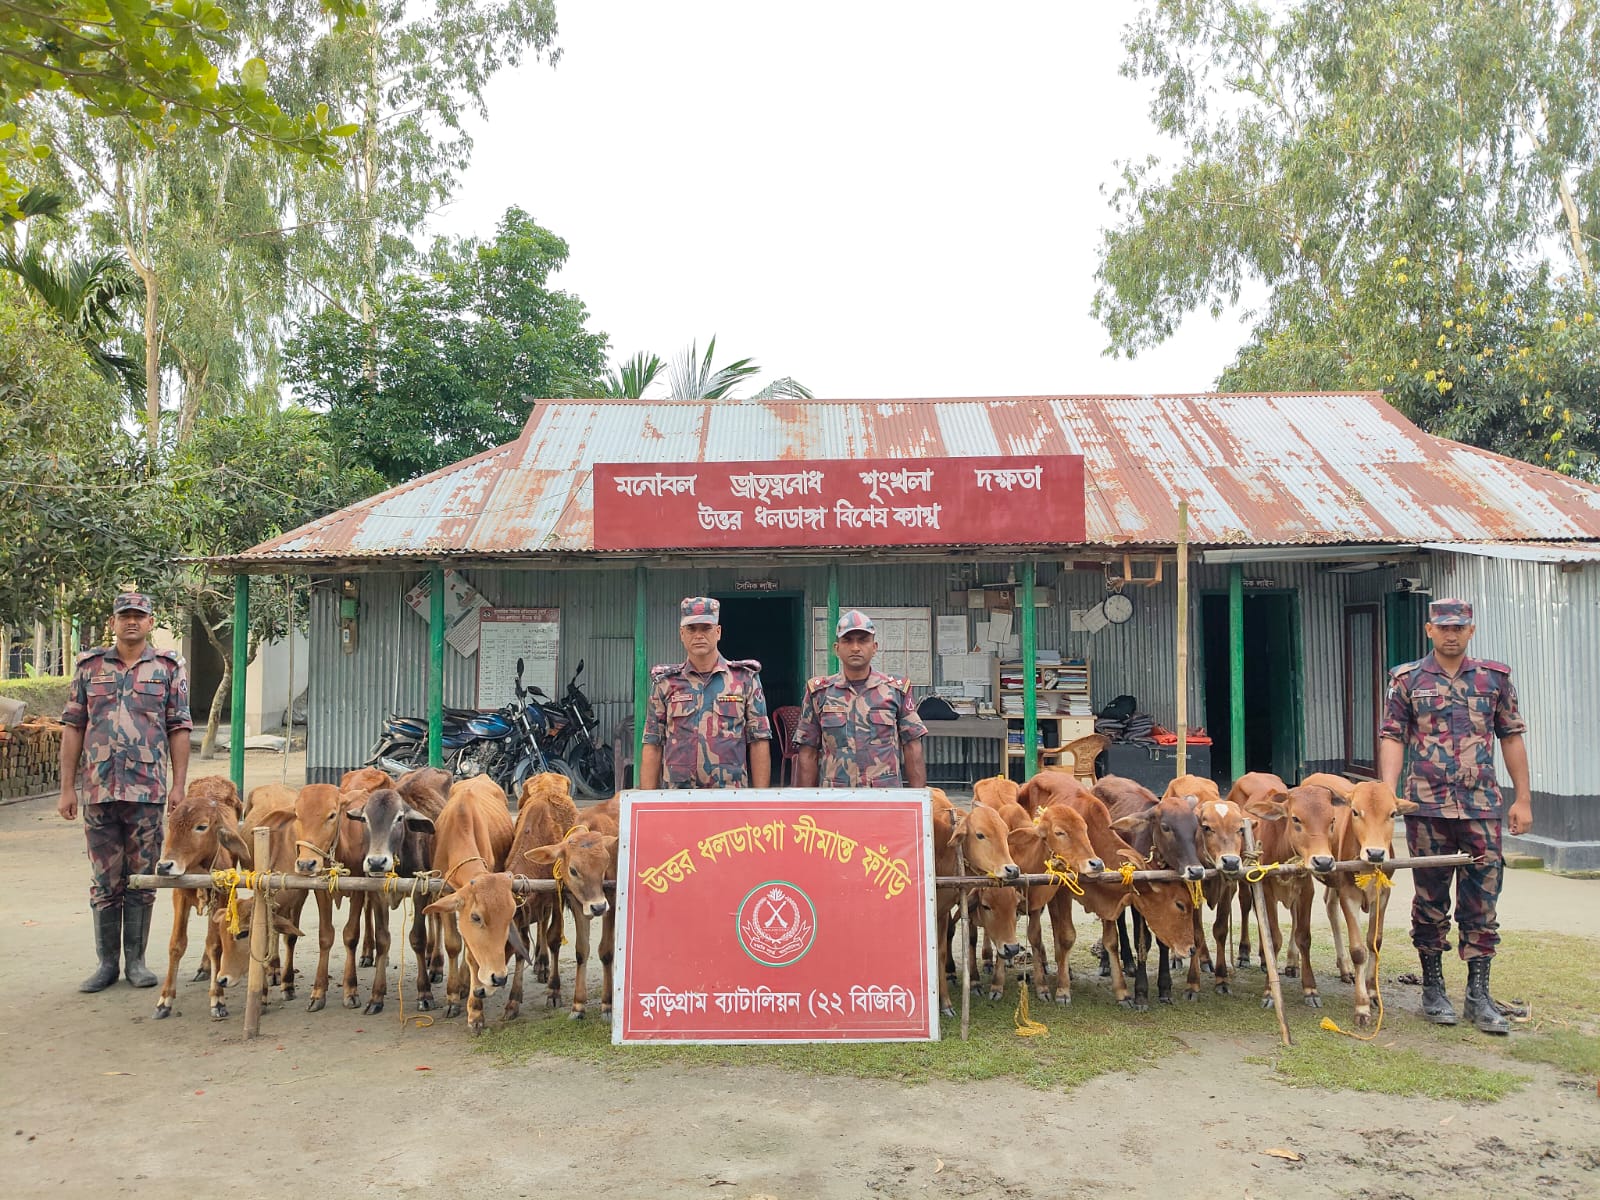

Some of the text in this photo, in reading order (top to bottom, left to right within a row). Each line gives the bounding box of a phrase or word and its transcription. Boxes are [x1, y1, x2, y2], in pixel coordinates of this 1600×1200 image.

[613, 465, 1043, 505] মনোবল ভ্রাতৃত্ববোধ শৃংখলা দক্ষতা
[697, 498, 942, 531] উত্তর ধলডাঙ্গা বিশেষ ক্যাম্প
[638, 814, 912, 900] উত্তর ধলডাংগা সীমান্ত ফাঁড়ি
[638, 985, 916, 1021] কুড়িগ্রাম ব্যাটালিয়ন (২২ বিজিবি)
